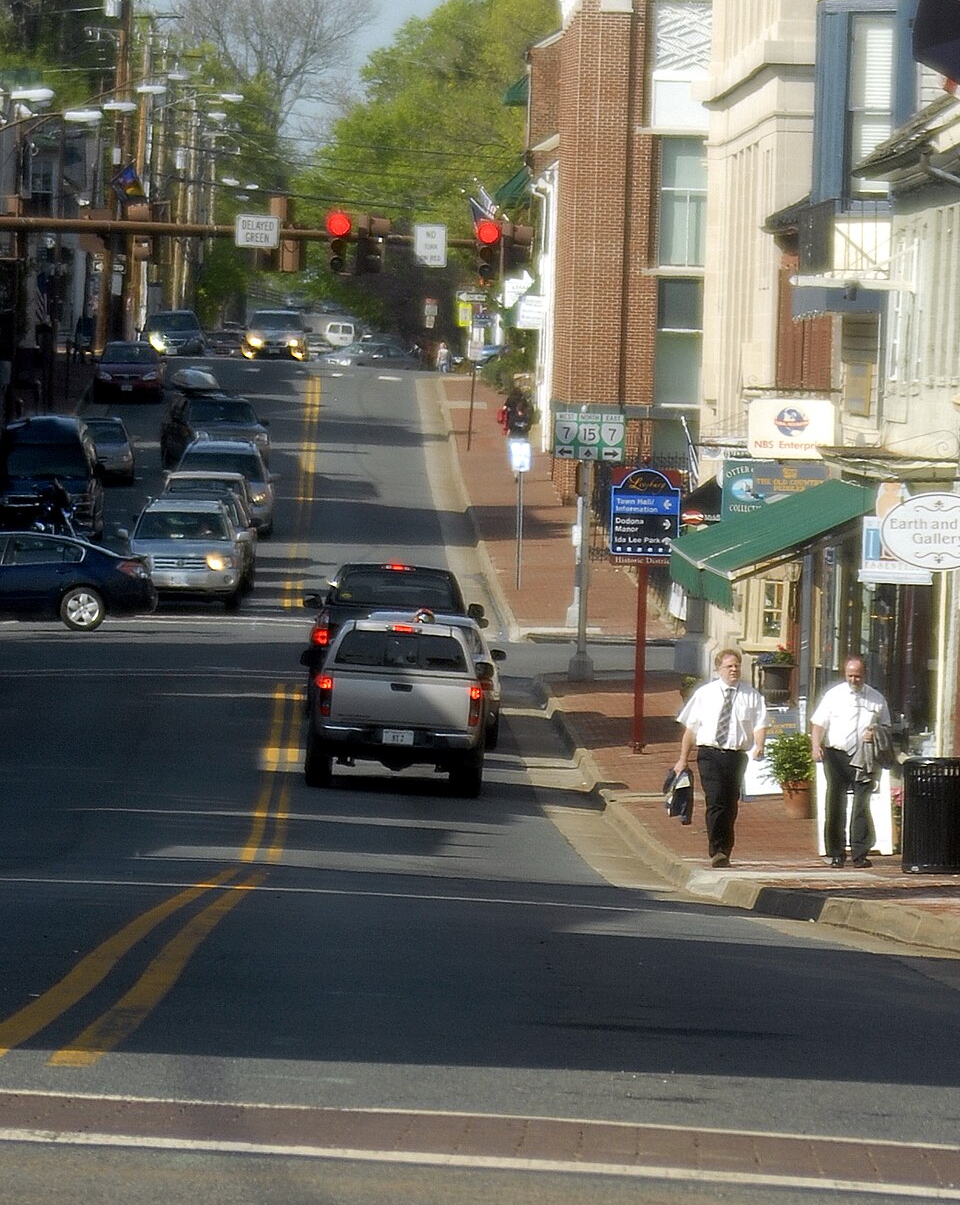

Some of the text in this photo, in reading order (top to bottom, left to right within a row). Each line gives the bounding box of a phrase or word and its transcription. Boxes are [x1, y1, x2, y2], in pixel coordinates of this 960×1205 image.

[241, 219, 275, 231] DELAYED
[245, 232, 270, 244] GREEN
[425, 230, 437, 239] NO
[562, 426, 616, 441] 7 15 7
[754, 440, 774, 448] NBS
[726, 465, 750, 478] OTTER
[615, 517, 644, 525] Dodona
[890, 518, 928, 530] Earth
[931, 518, 958, 530] and
[616, 556, 644, 564] Historic
